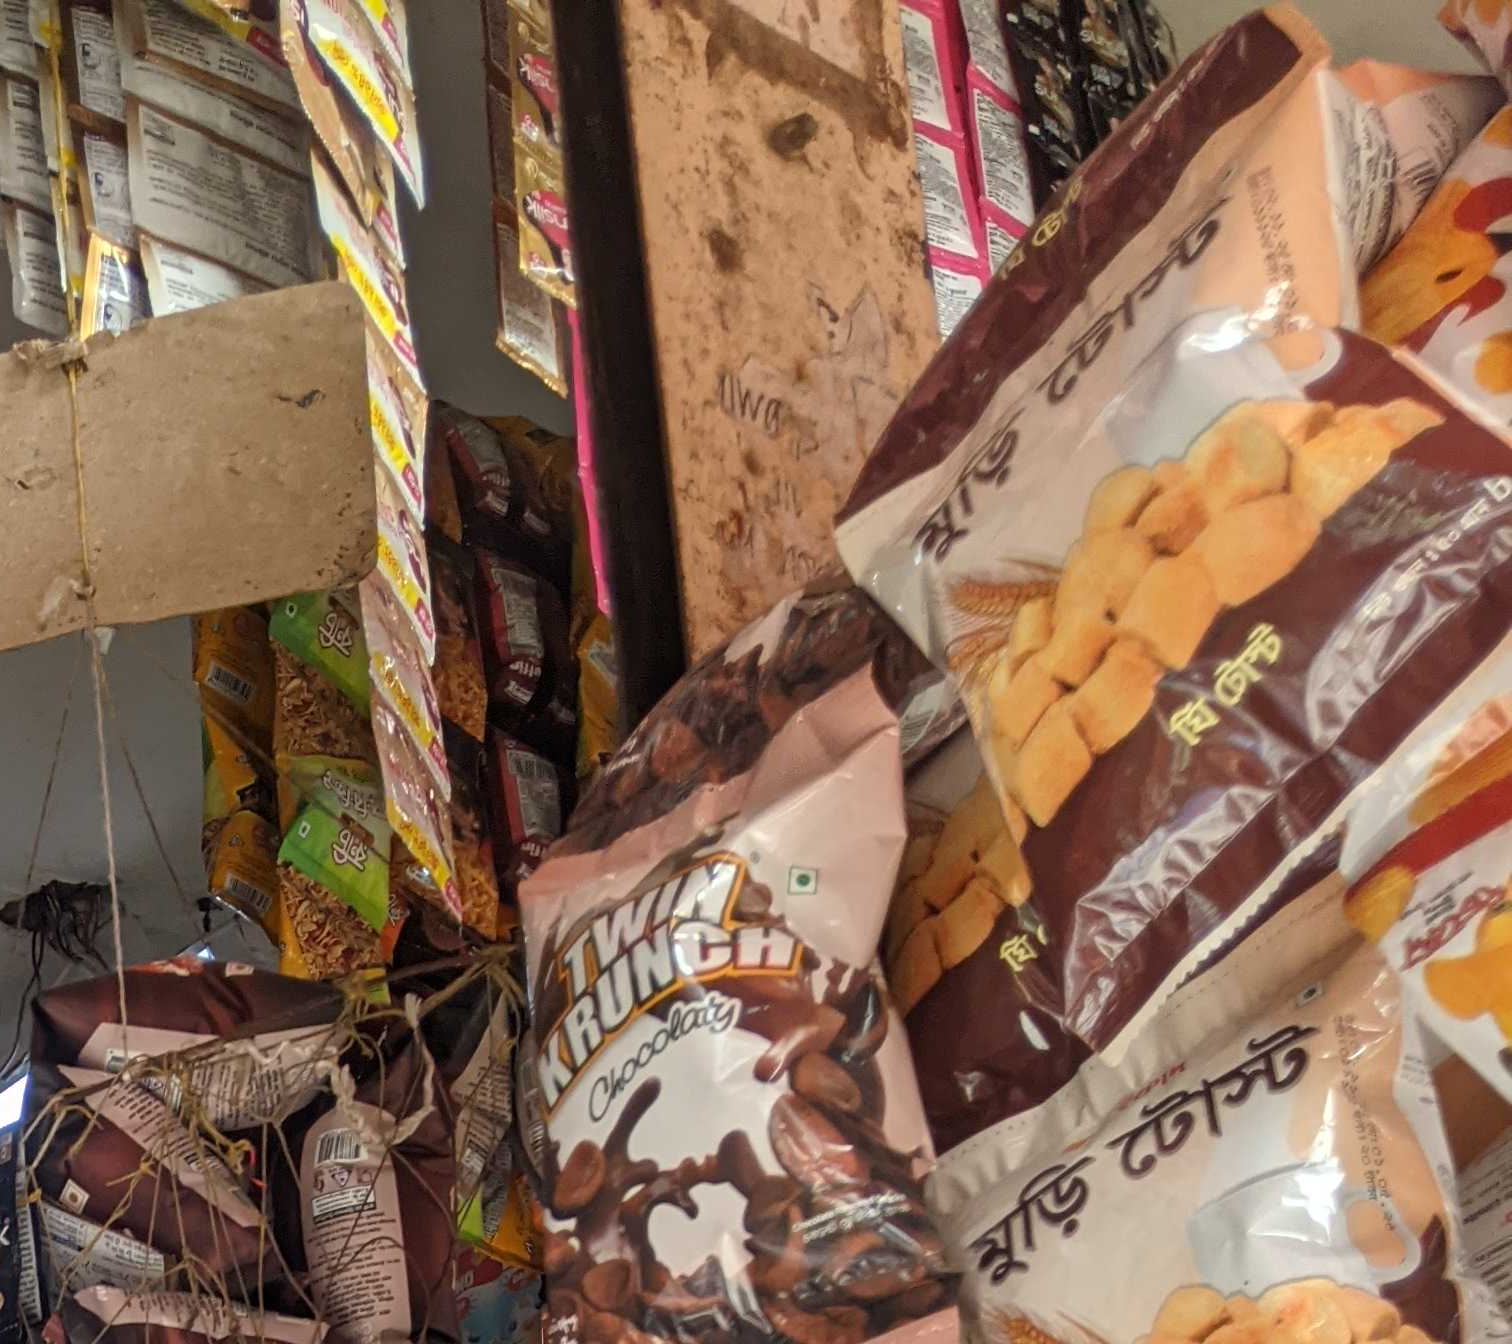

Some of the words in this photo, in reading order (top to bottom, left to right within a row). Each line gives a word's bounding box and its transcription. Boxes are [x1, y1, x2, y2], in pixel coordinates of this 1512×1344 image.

[561, 853, 742, 998] TWIN
[539, 922, 801, 1108] KRUNCH
[588, 996, 740, 1122] Chocolaty
[968, 1152, 1096, 1288] মুড়ি
[1107, 1021, 1321, 1181] টোস্ট
